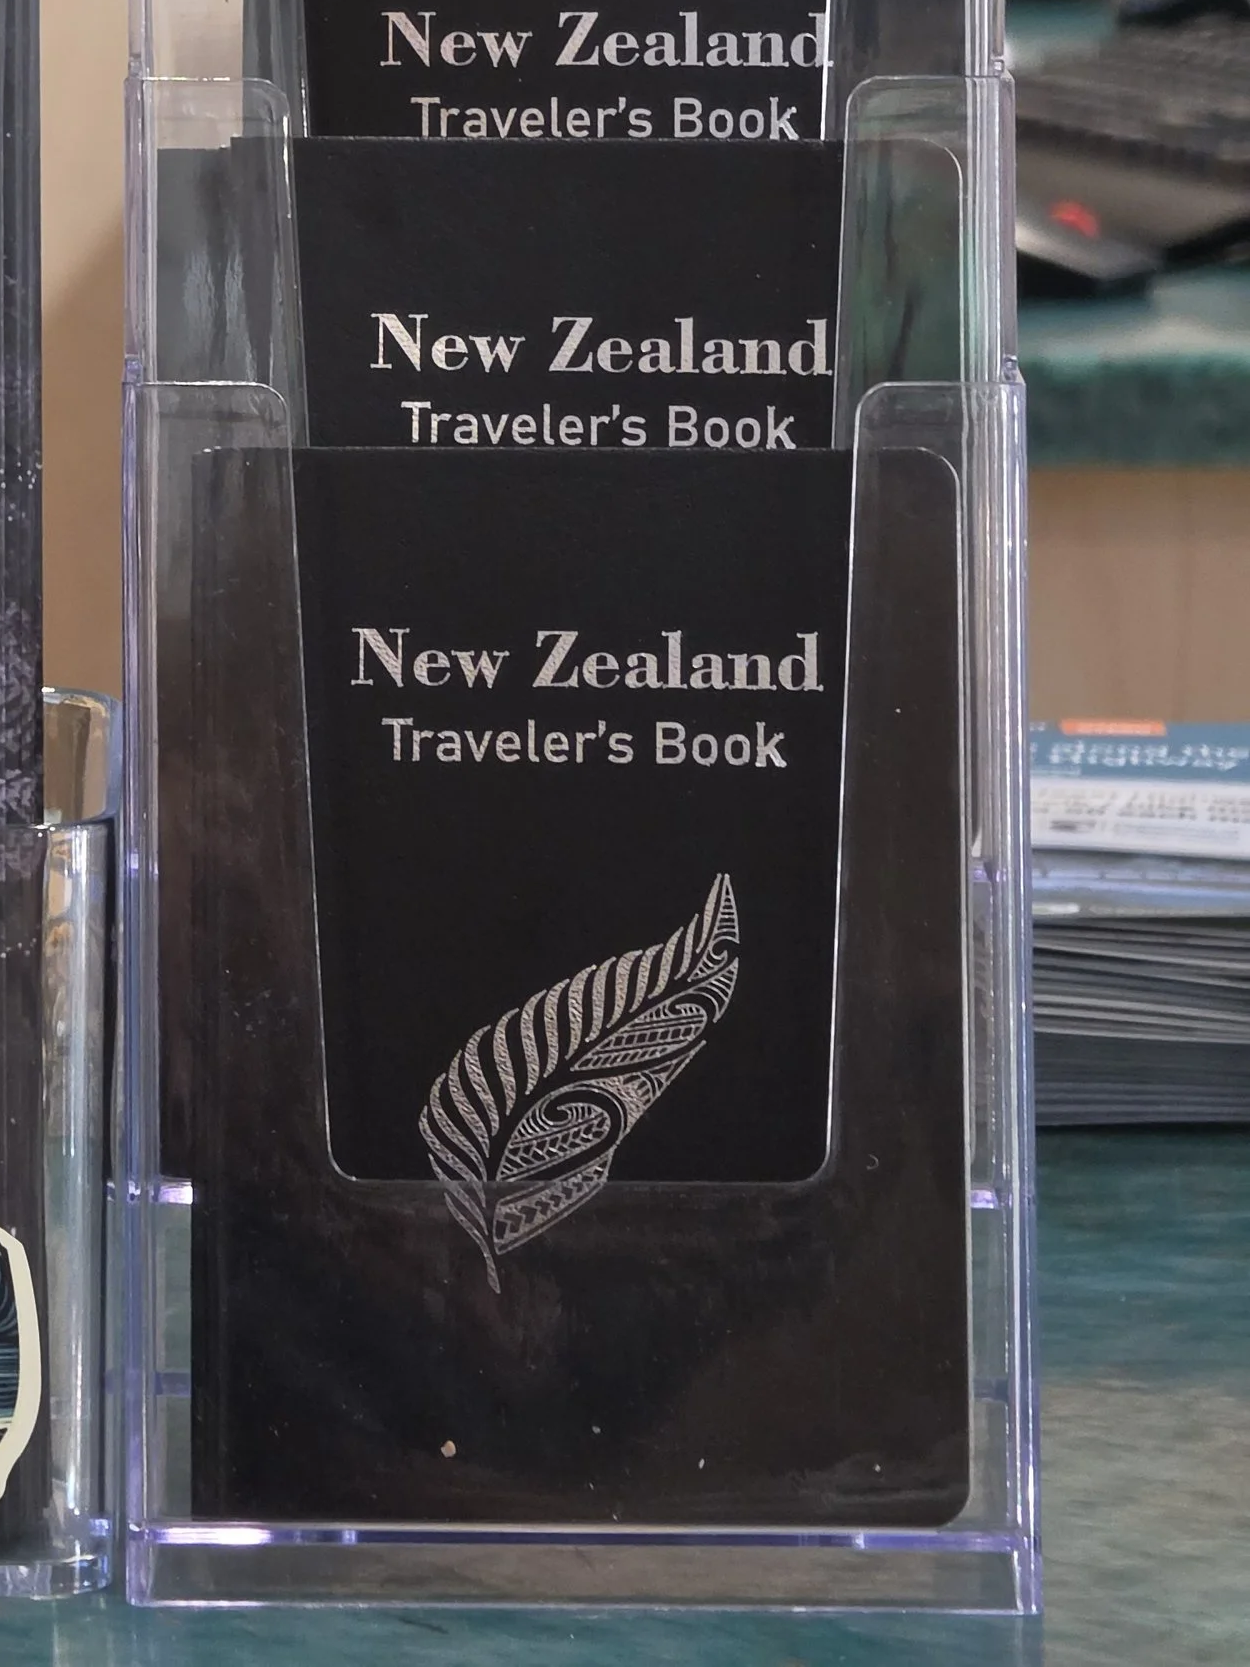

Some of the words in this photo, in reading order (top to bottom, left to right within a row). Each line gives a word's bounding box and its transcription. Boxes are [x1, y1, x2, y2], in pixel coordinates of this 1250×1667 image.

[380, 11, 533, 68] New
[554, 11, 834, 68] Zealand
[410, 97, 653, 138] Traveler's
[673, 97, 800, 140] Book
[369, 313, 526, 373] New
[549, 315, 834, 376] Zealand
[400, 400, 647, 446] Traveler's
[667, 404, 796, 450] Book
[351, 628, 510, 688] New
[532, 630, 824, 692] Zealand
[381, 718, 634, 764] Traveler's
[654, 721, 787, 768] Book
